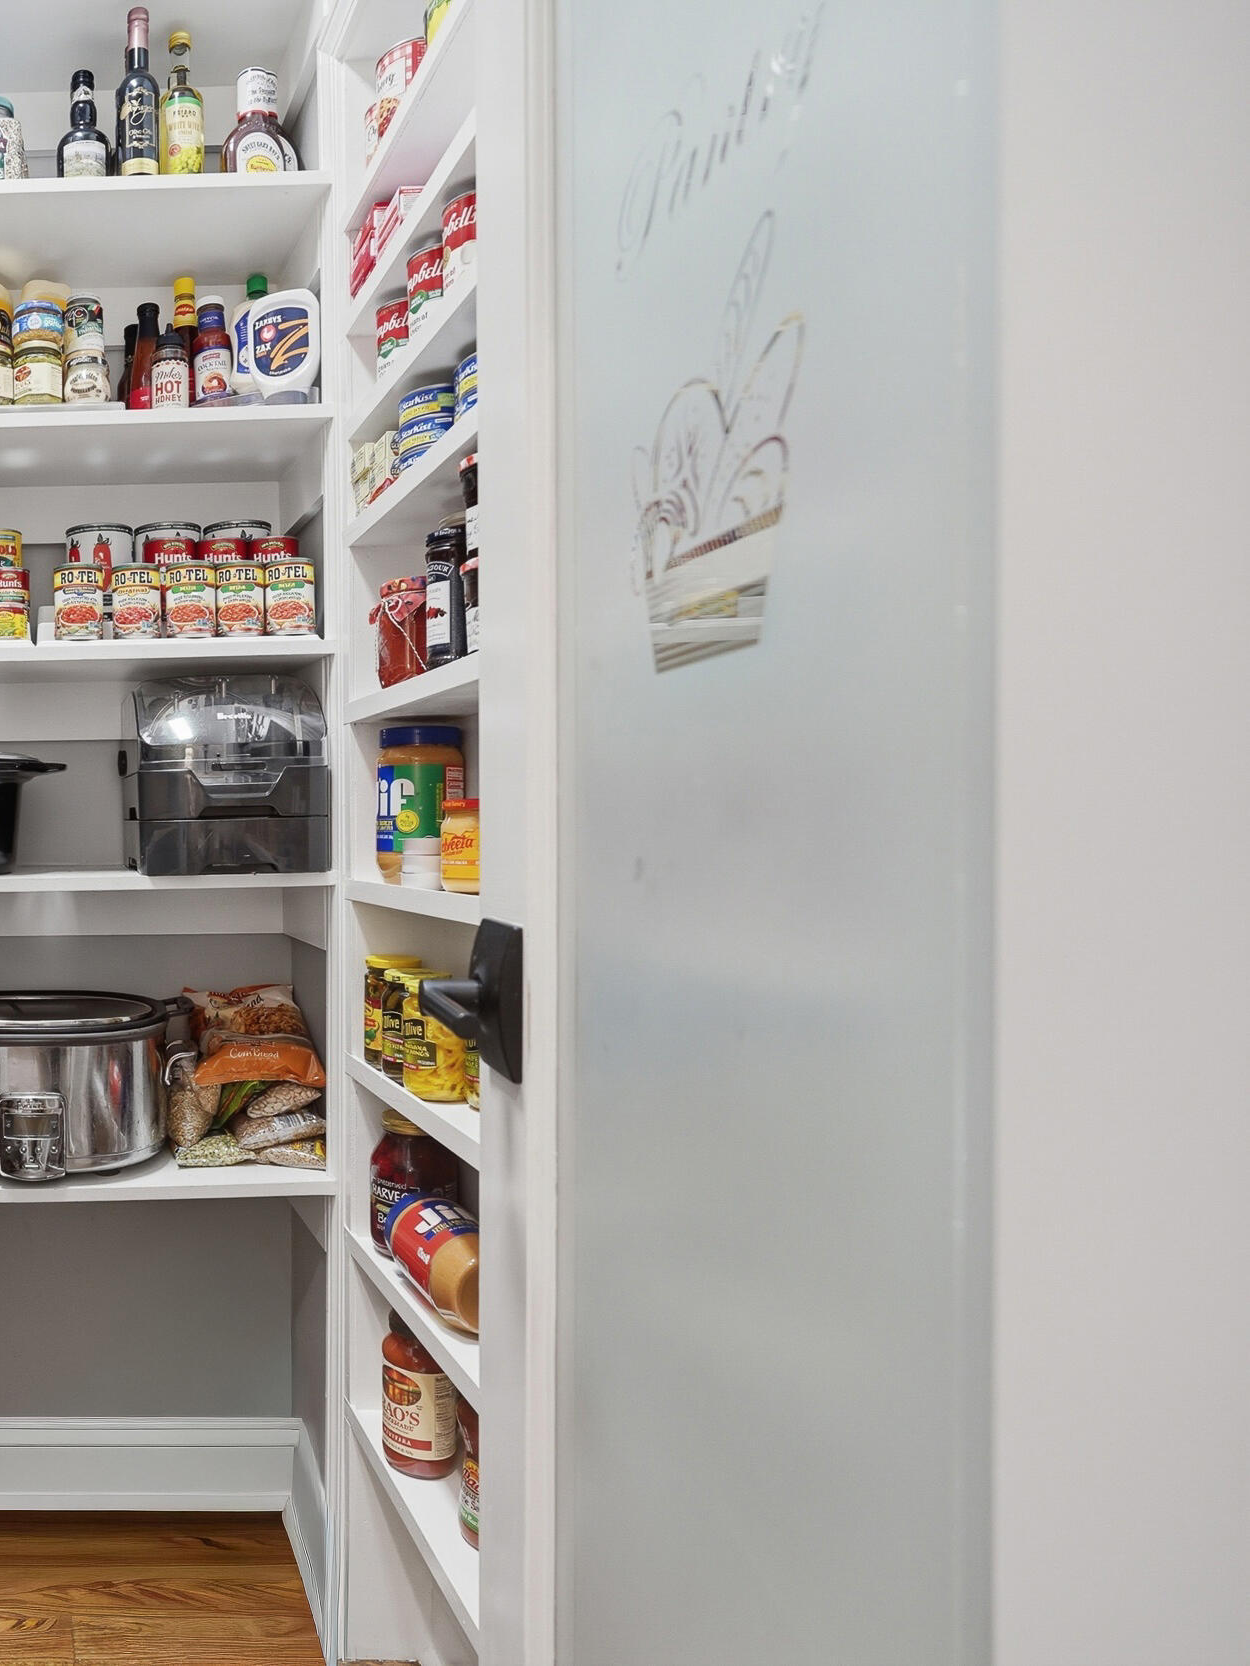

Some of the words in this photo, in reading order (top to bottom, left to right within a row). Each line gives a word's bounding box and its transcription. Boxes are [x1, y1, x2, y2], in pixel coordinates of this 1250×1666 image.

[256, 342, 271, 353] ZAX
[155, 381, 182, 396] HOT
[155, 394, 182, 404] HONEY
[378, 778, 415, 817] if
[372, 1183, 408, 1202] HARVE
[384, 1404, 420, 1427] AO'S
